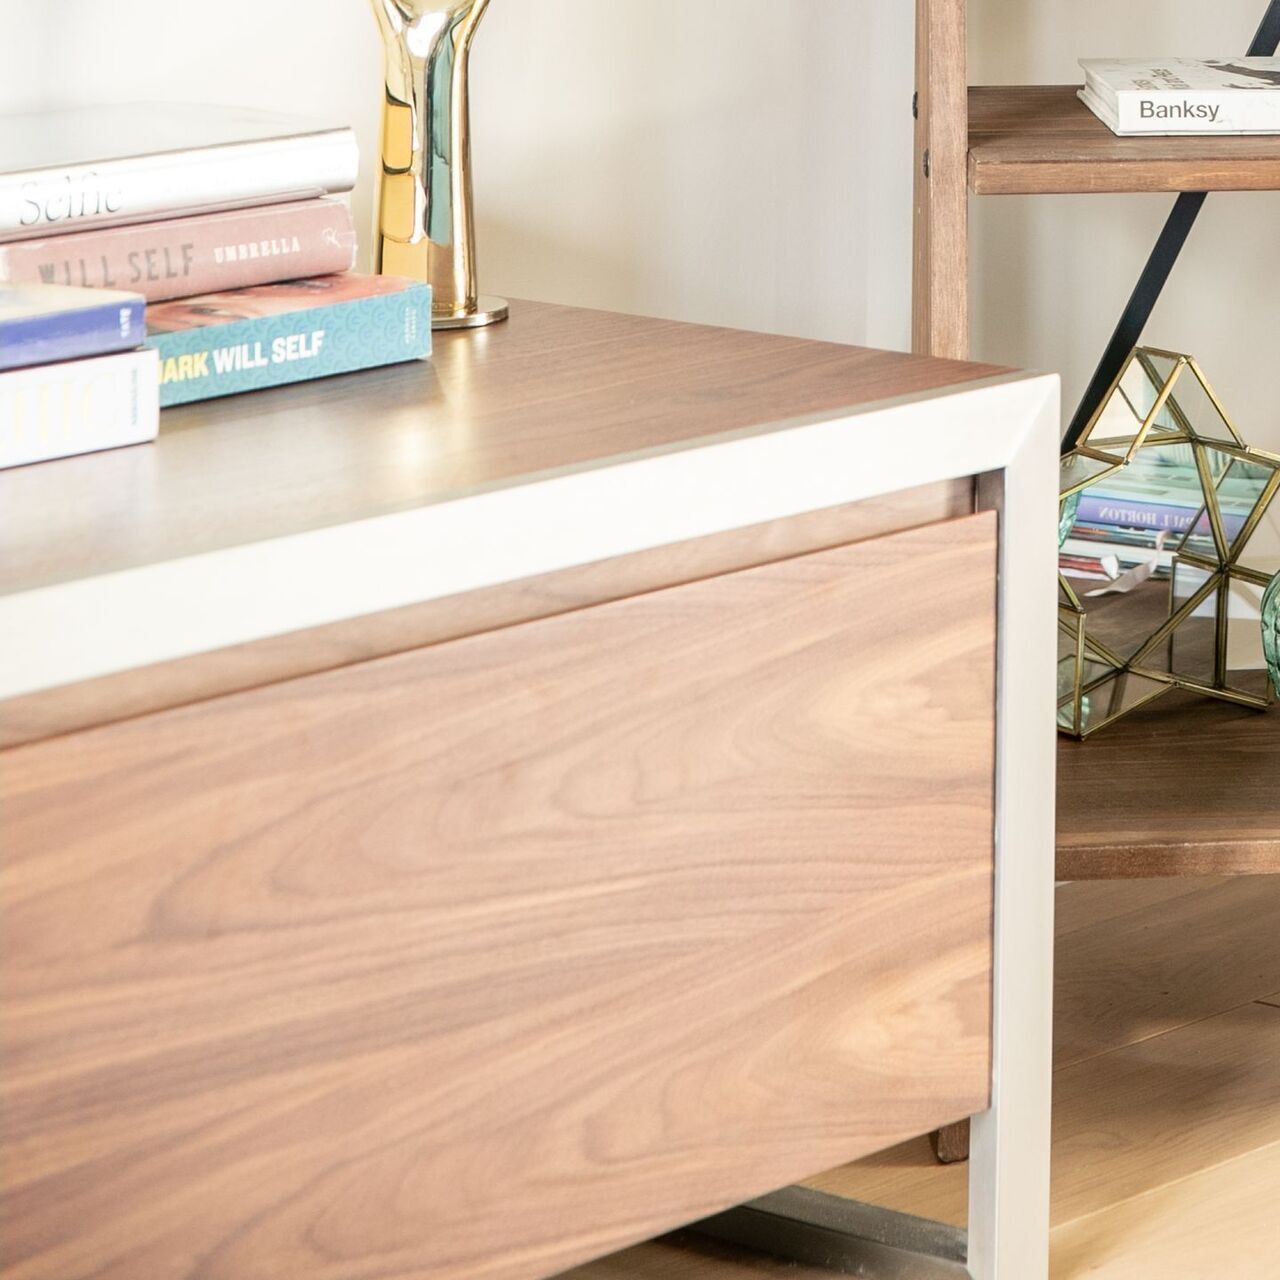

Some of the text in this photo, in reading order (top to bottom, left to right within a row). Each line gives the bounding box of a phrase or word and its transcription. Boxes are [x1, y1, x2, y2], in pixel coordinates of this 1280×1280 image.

[1140, 100, 1220, 122] Banksy
[37, 237, 301, 289] WILL SELF UMBRELLA
[212, 338, 269, 374] WILL
[271, 330, 325, 364] SELF
